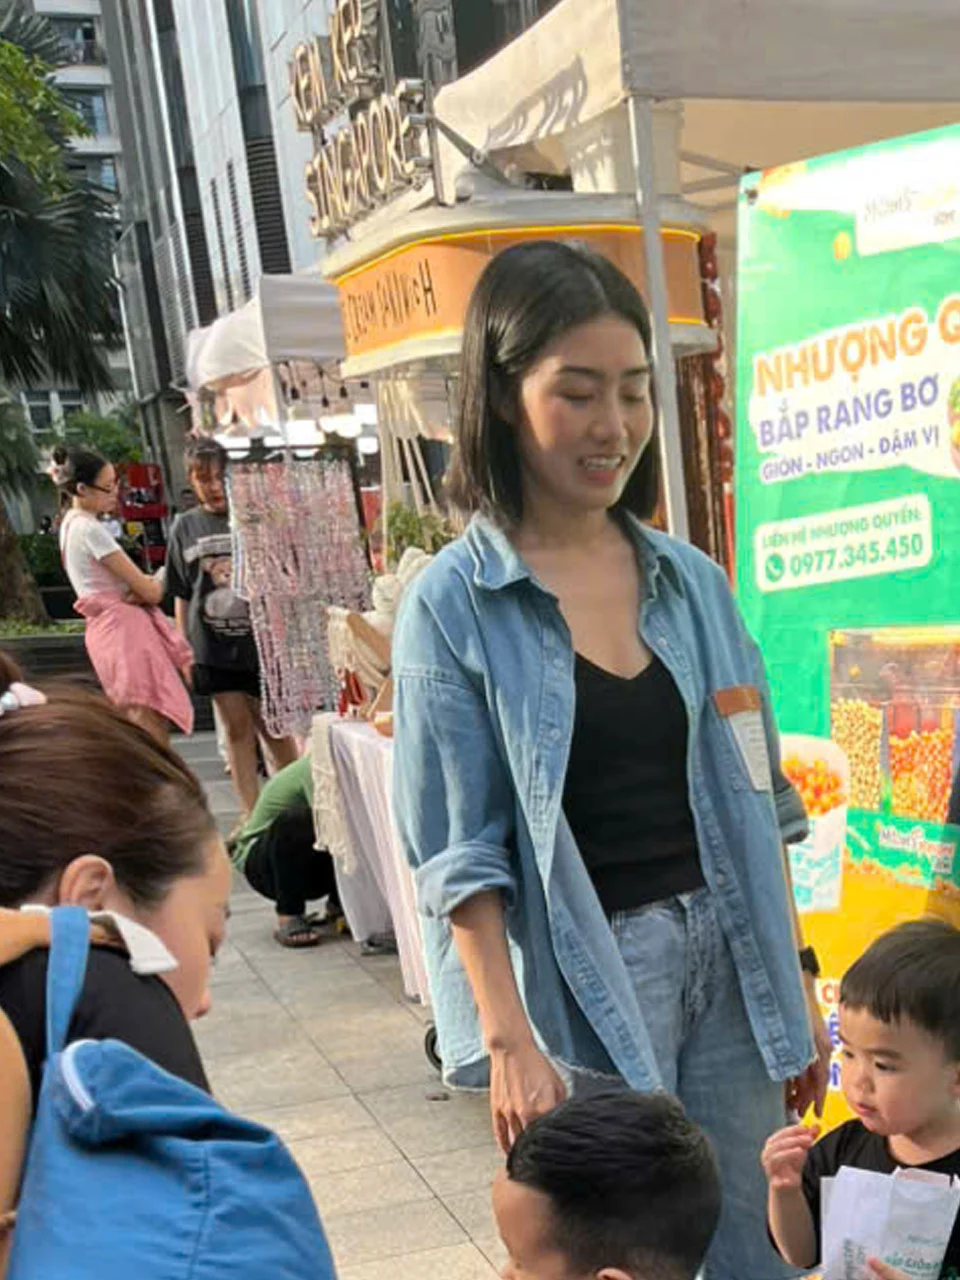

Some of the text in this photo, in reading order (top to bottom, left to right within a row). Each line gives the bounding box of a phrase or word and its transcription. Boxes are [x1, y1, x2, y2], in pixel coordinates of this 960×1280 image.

[305, 78, 424, 238] SINGAPORE
[756, 309, 928, 396] NHƯỢNG
[759, 373, 939, 447] BẮP RANG BƠ
[816, 442, 864, 469] NGON
[790, 533, 923, 577] 0977.345.450
